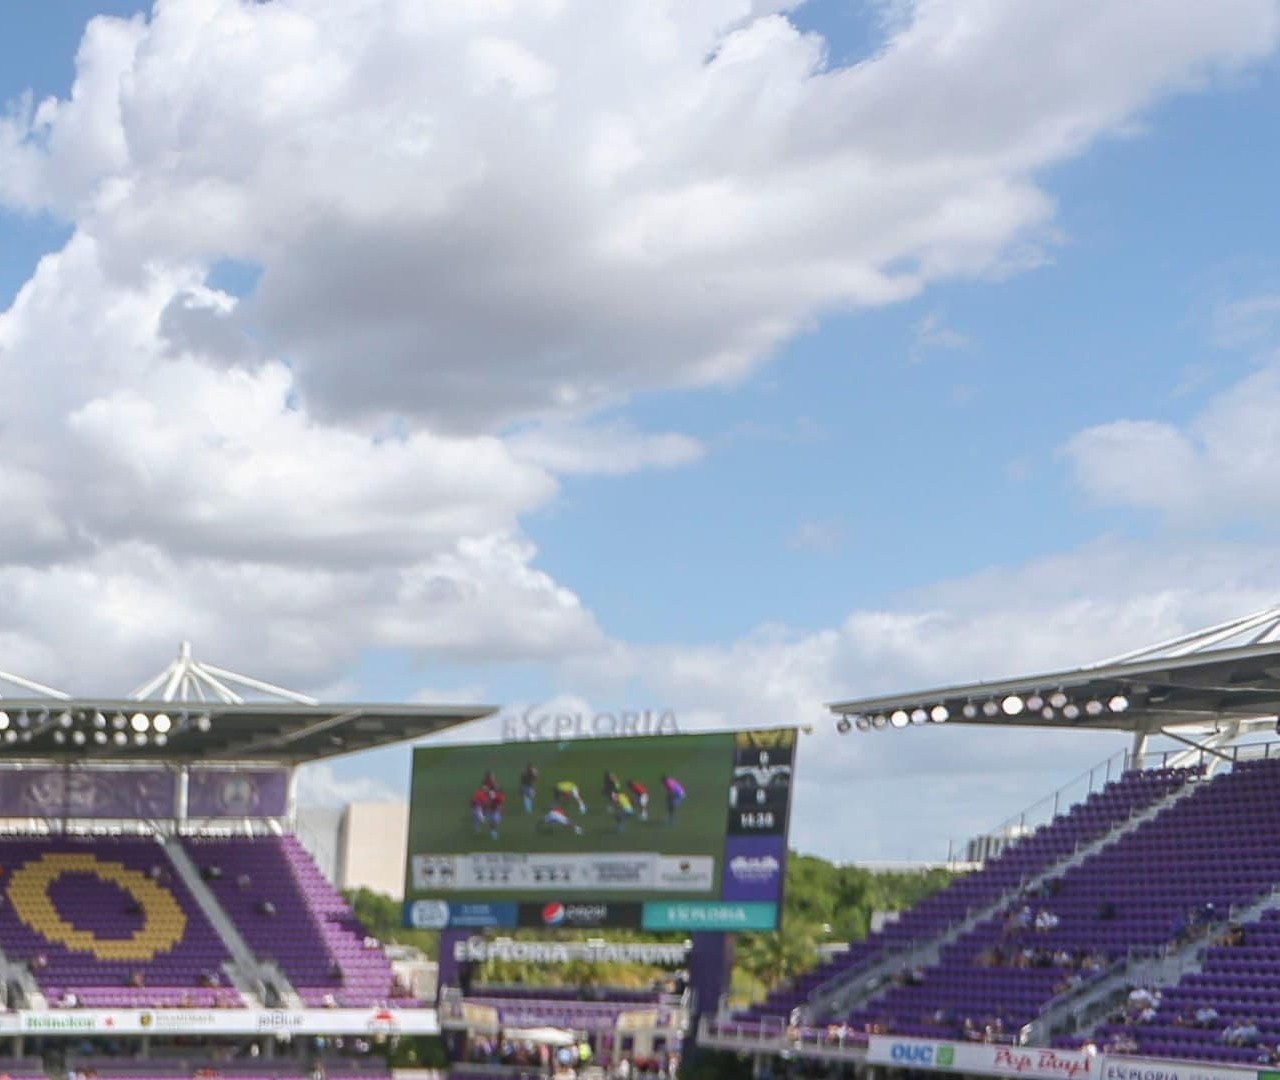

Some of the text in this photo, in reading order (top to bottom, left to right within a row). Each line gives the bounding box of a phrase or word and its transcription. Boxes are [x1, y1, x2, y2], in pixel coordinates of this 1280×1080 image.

[502, 705, 679, 742] EXPLORIA
[454, 938, 568, 962] EXPLORIA
[891, 1043, 932, 1065] OUC
[994, 1046, 1032, 1072] Pep
